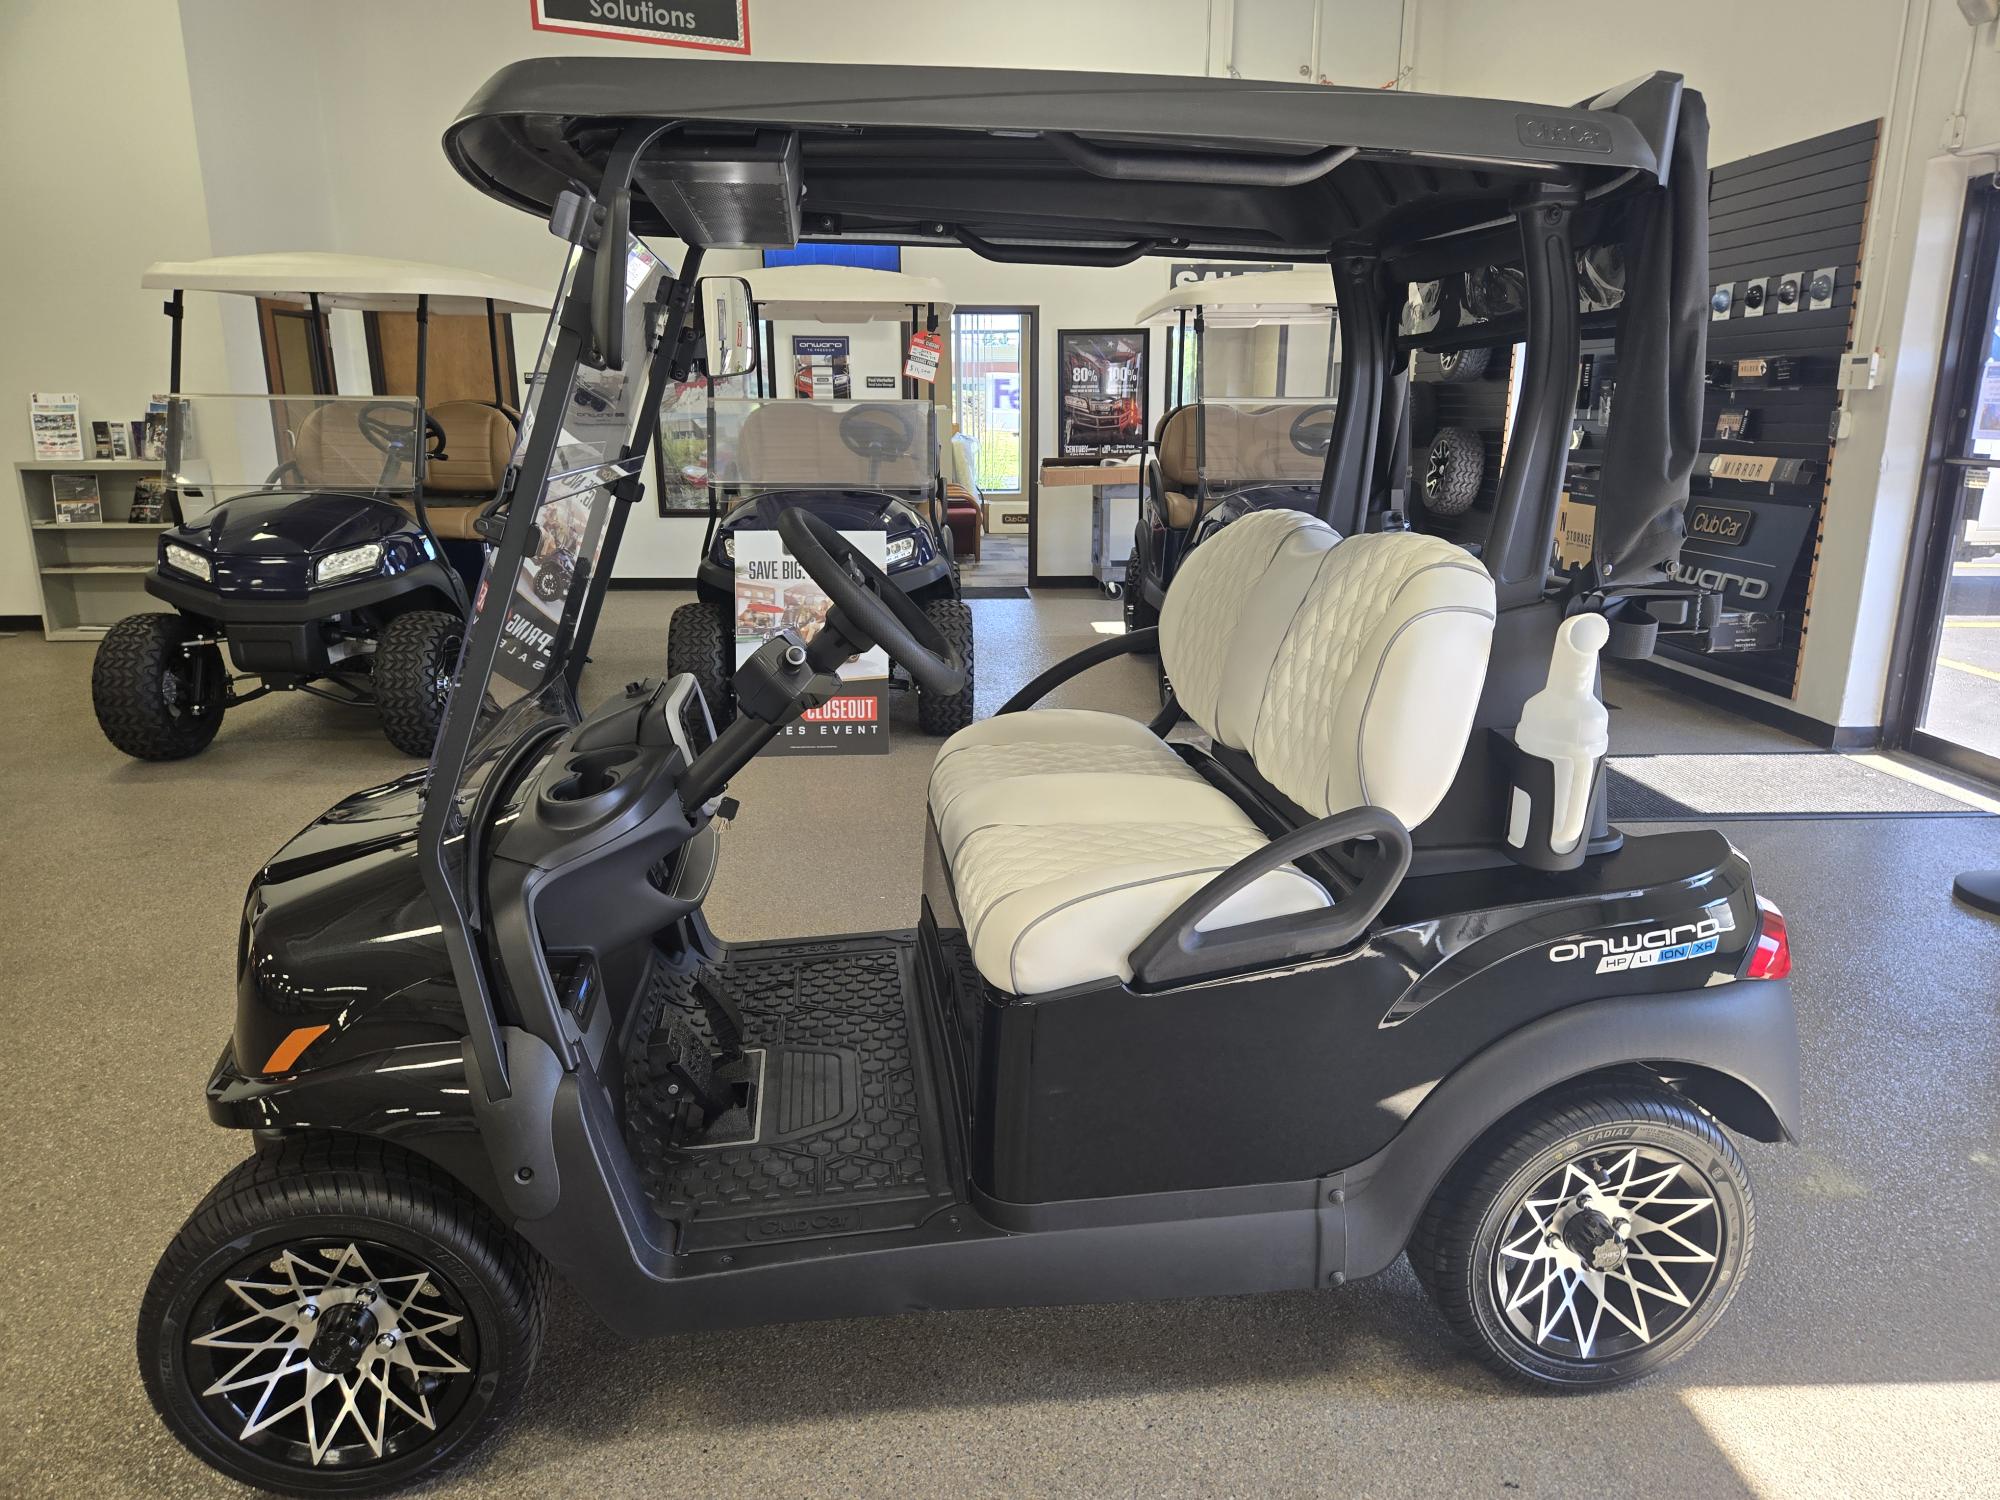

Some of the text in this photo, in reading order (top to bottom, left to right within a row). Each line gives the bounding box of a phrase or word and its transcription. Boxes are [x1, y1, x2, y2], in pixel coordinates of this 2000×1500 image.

[589, 0, 697, 29] Solutions
[1073, 367, 1098, 382] 80%
[1723, 462, 1764, 478] MIRROR
[1693, 512, 1742, 536] Club Car
[748, 560, 806, 580] SAVE BIG.
[1669, 563, 1769, 600] ward
[820, 725, 878, 735] EVENT
[1549, 918, 1720, 963] onward
[1606, 957, 1627, 968] HP
[1696, 941, 1713, 952] XR
[1586, 1127, 1631, 1142] RADIAL
